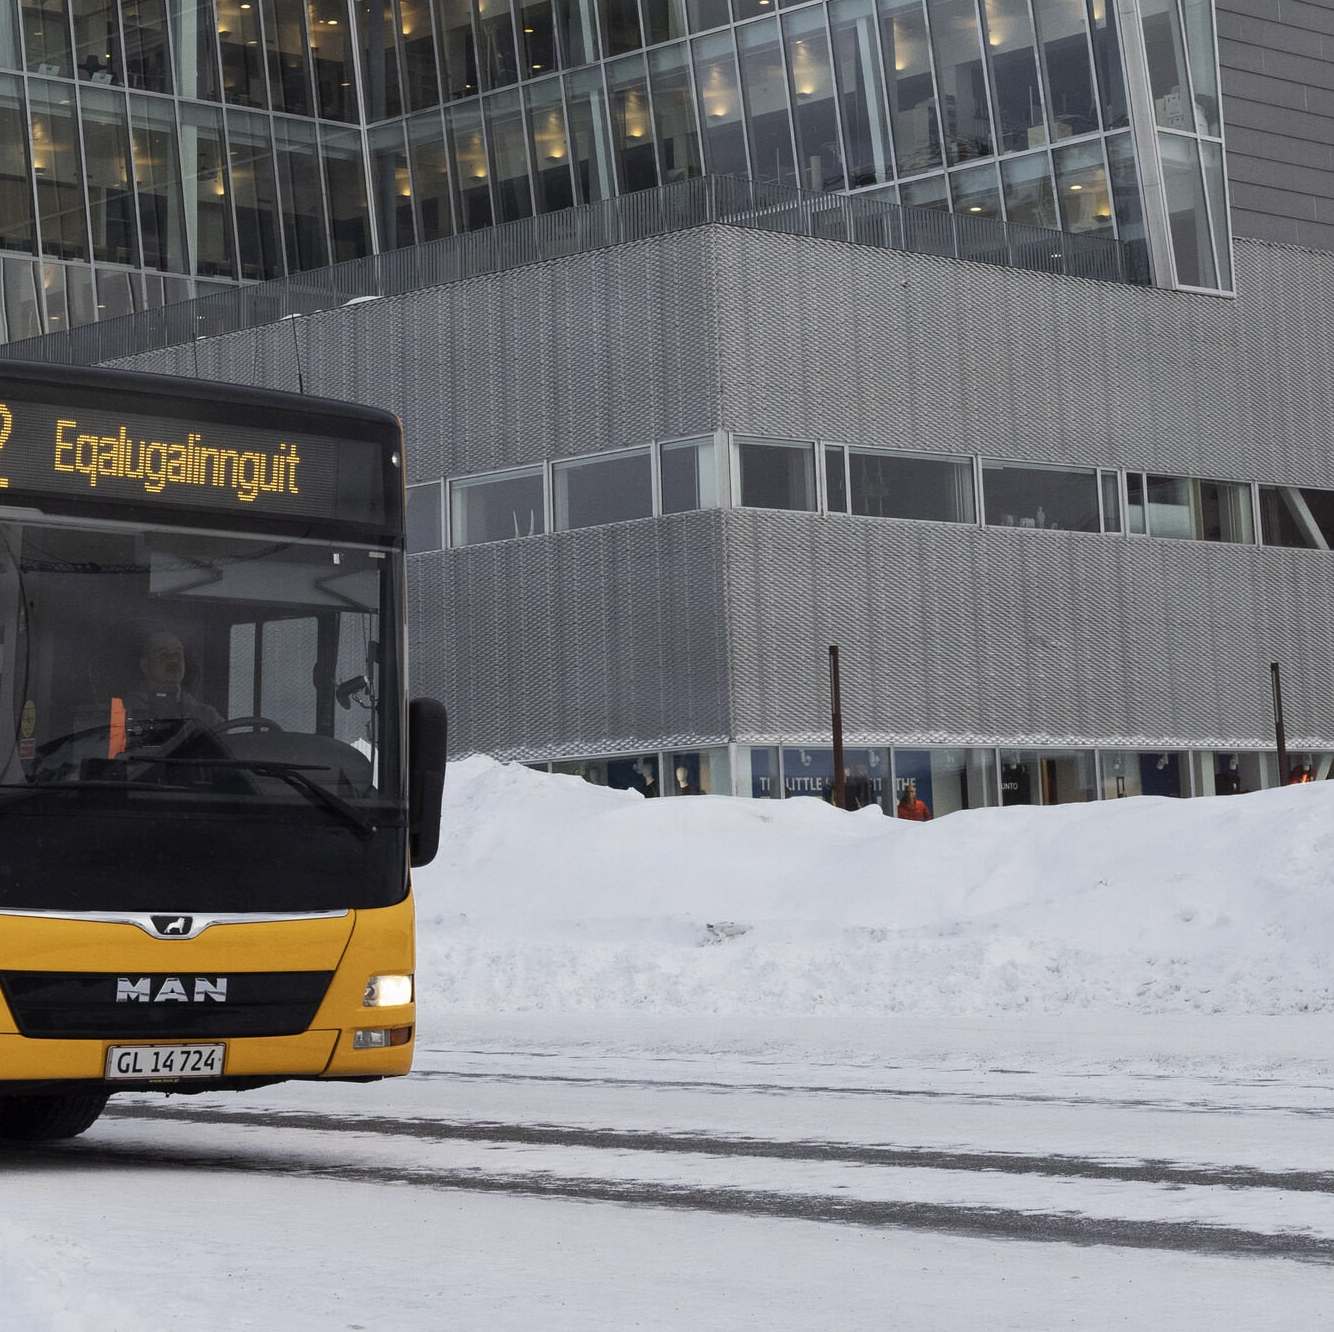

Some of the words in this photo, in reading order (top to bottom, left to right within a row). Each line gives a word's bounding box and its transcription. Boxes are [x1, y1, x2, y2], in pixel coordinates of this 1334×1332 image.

[54, 420, 300, 502] Eqalugalinnguit
[785, 777, 822, 791] LITTLE
[1000, 782, 1019, 790] UNTO
[116, 977, 227, 1002] MAN
[117, 1051, 143, 1073] GL
